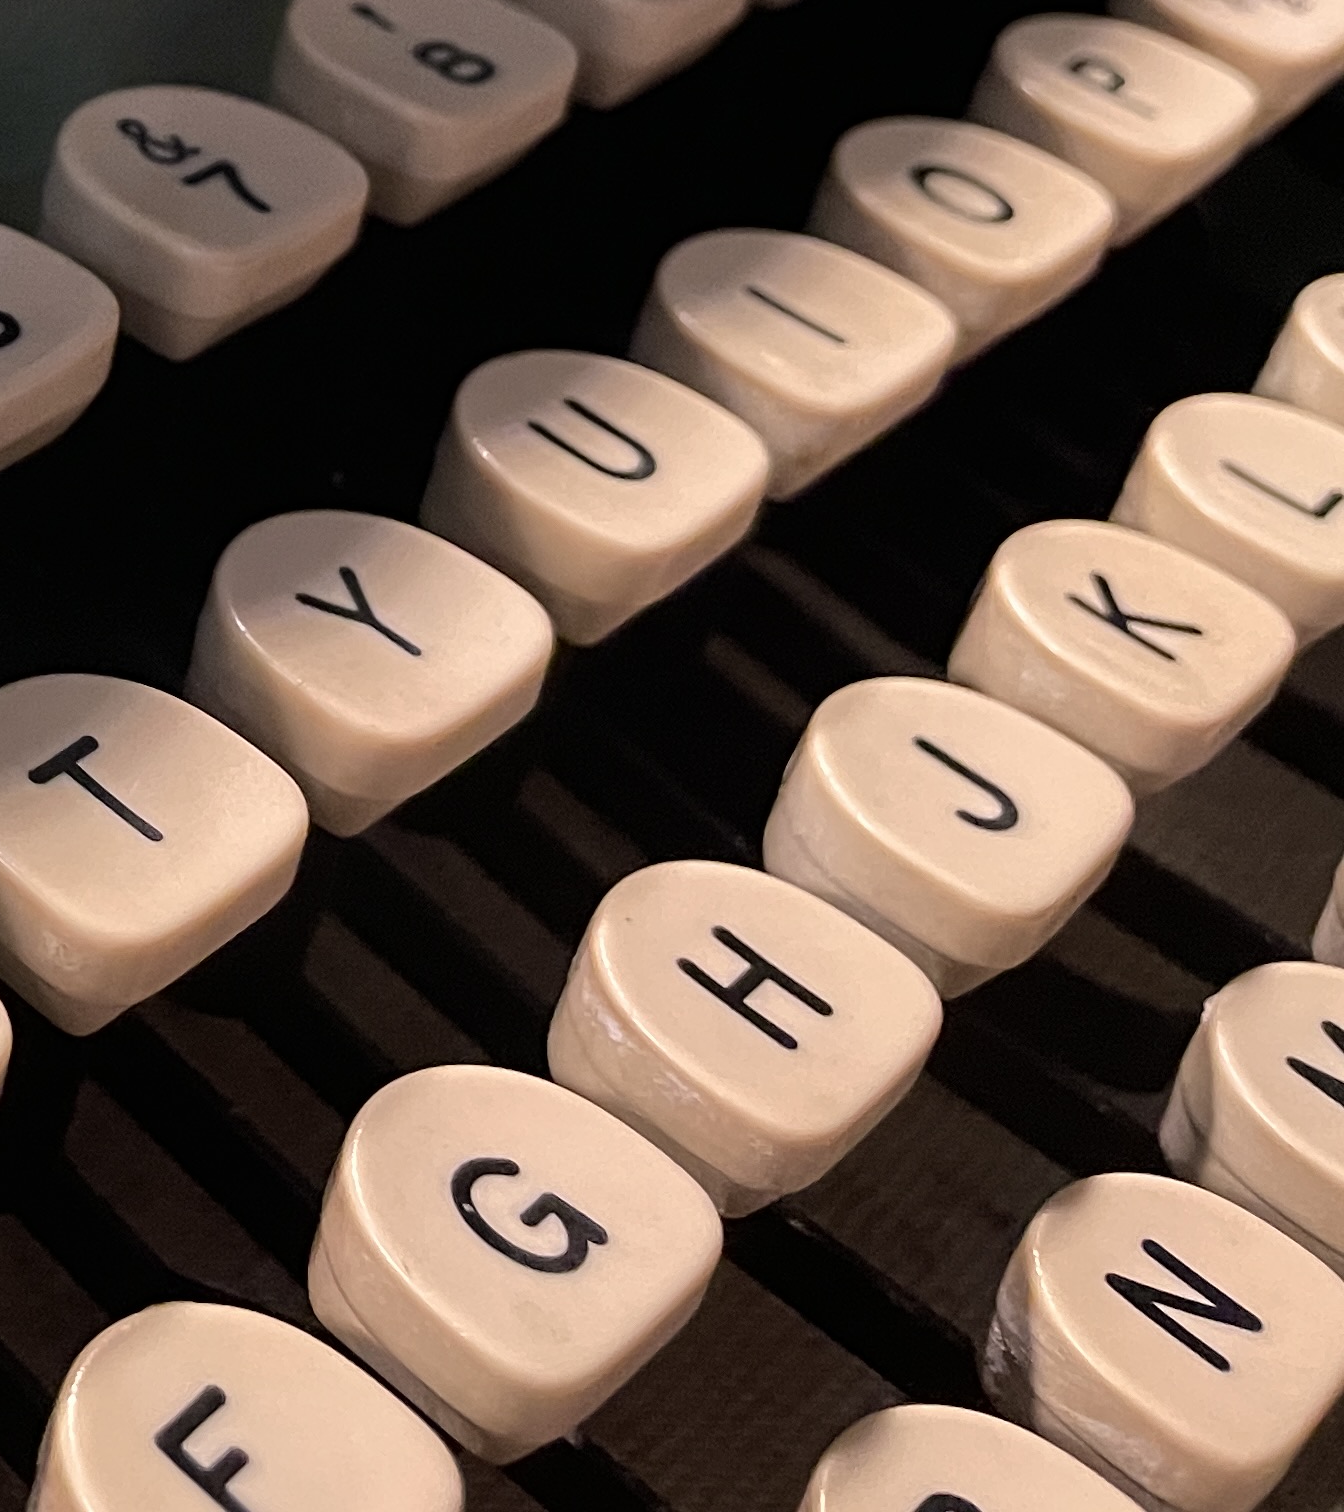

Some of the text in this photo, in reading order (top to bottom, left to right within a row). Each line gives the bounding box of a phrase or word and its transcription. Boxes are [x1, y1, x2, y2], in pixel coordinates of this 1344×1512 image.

[412, 41, 496, 86] 8
[1066, 55, 1159, 121] P
[116, 118, 200, 165] &
[181, 159, 272, 214] 7
[525, 396, 657, 481] U
[1220, 458, 1344, 519] L
[294, 566, 422, 656] Y
[1067, 570, 1204, 662] K
[27, 734, 164, 843] T
[913, 736, 1019, 831] J
[676, 925, 834, 1051] H
[450, 1157, 609, 1274] G
[1104, 1238, 1264, 1373] N
